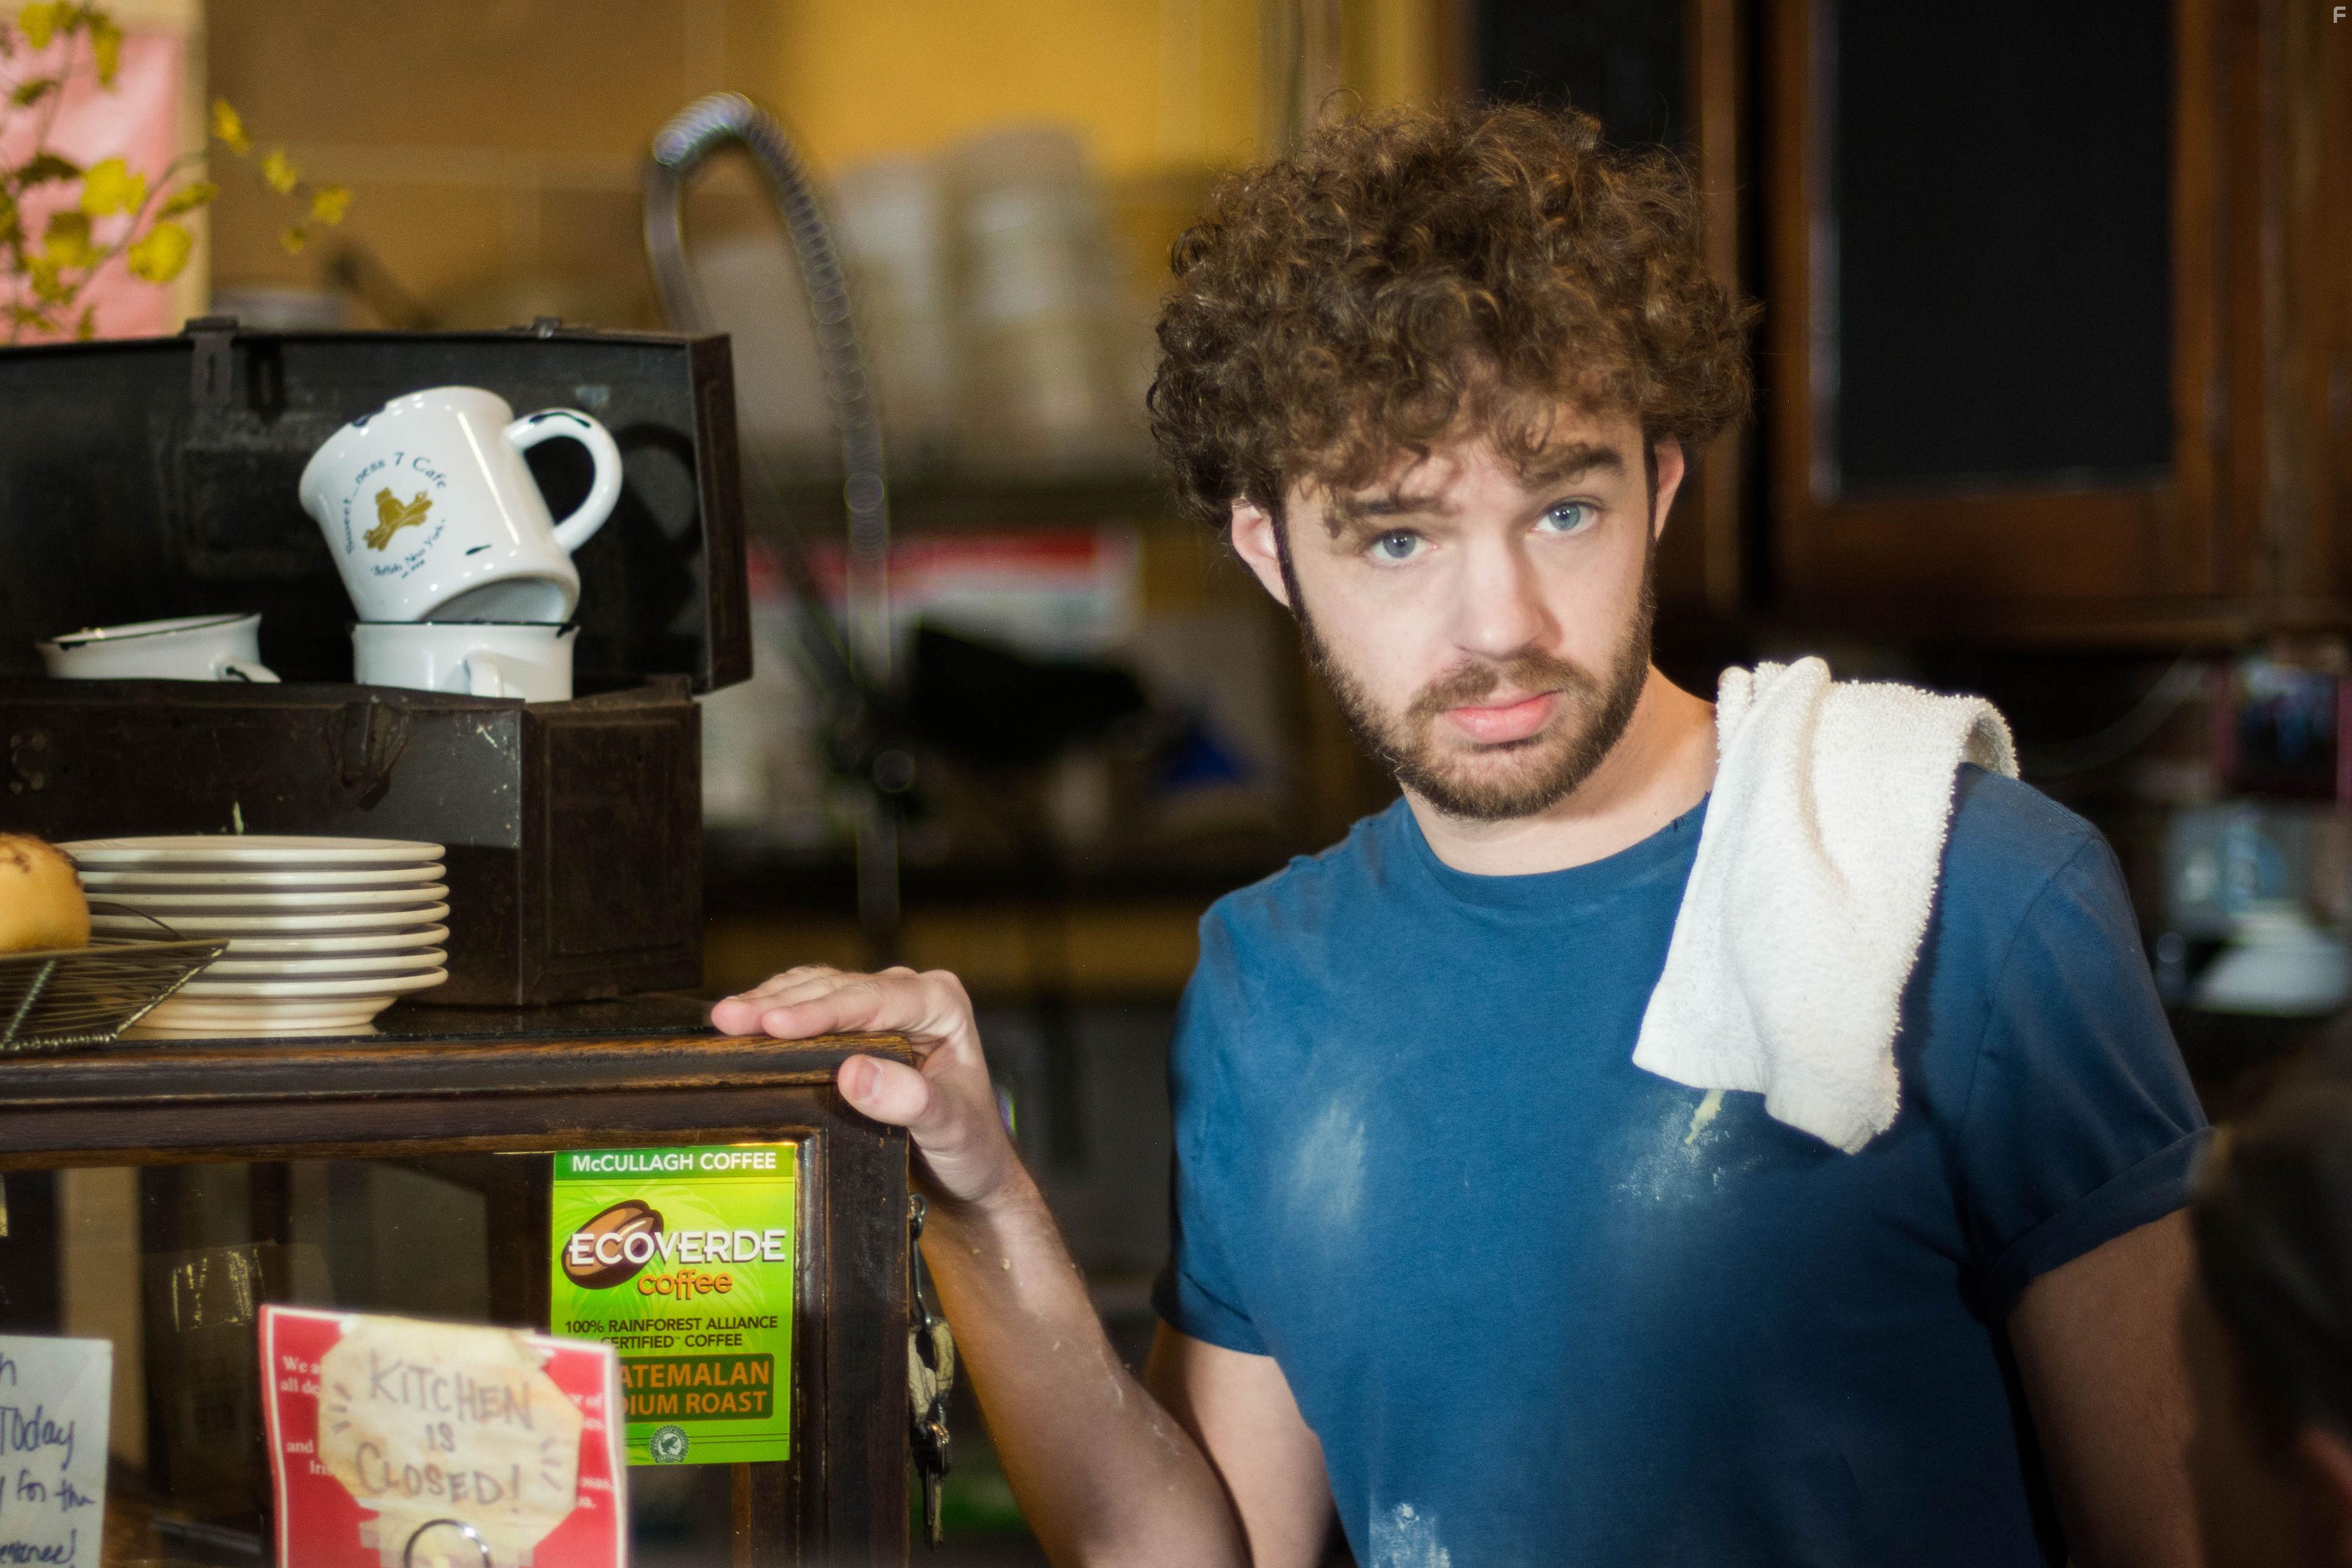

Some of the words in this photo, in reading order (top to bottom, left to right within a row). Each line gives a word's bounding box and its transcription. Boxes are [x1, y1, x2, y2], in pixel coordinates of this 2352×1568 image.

[394, 451, 405, 466] 7
[412, 457, 447, 489] Cafe
[572, 1152, 693, 1172] McCULLAGH
[699, 1152, 777, 1170] COFFEE
[568, 1229, 787, 1266] ECOVERDE
[638, 1268, 733, 1300] coffee
[564, 1318, 605, 1334] 100%
[608, 1317, 702, 1333] RAINFOREST
[706, 1315, 779, 1330] ALLIANCE
[684, 1333, 743, 1348] COFFEE
[370, 1347, 535, 1431] KITCHEN
[686, 1390, 768, 1414] ROAST
[286, 1439, 314, 1454] and
[426, 1420, 455, 1452] IS
